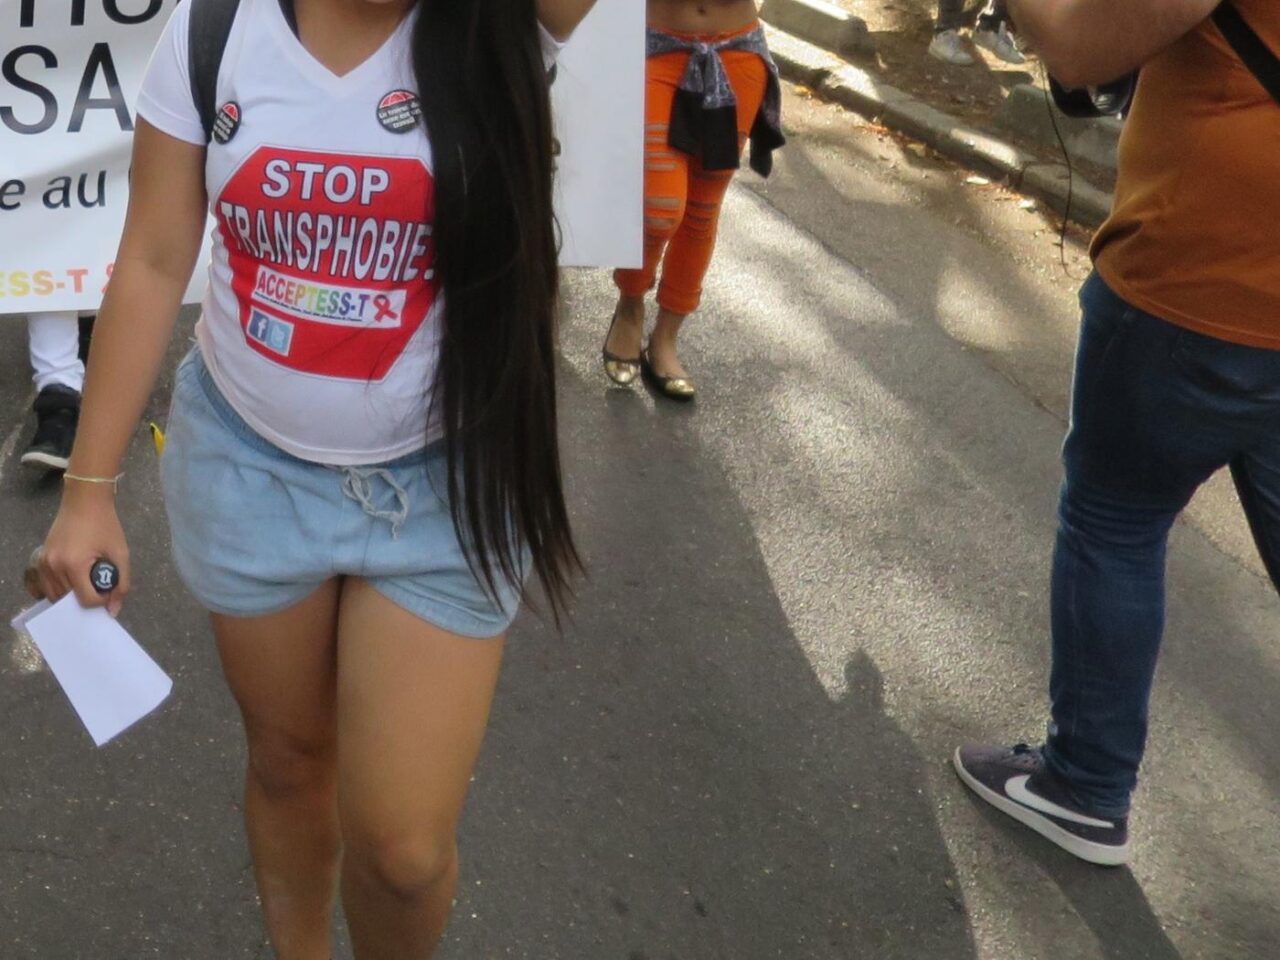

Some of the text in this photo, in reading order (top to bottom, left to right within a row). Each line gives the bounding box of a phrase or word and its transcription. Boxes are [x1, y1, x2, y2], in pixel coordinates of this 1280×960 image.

[42, 170, 107, 209] au
[261, 159, 389, 205] STOP
[258, 271, 370, 318] ACCEPTESS-T
